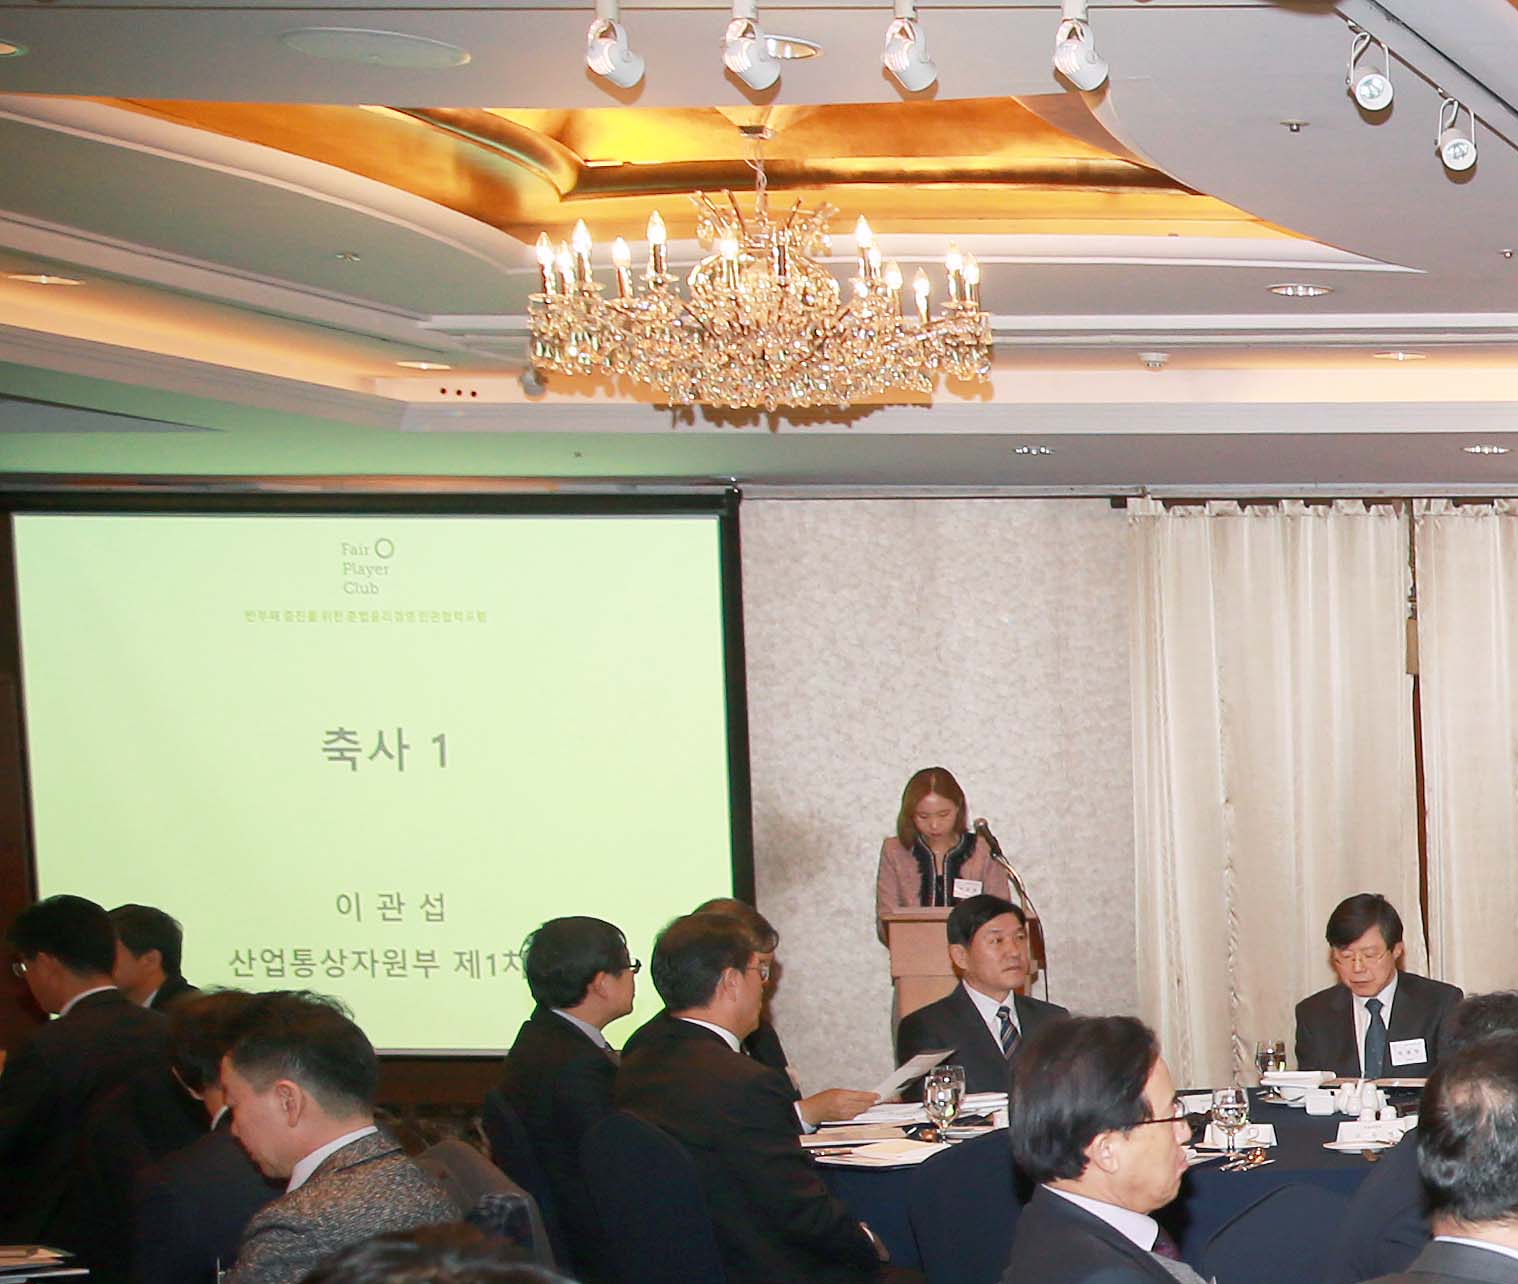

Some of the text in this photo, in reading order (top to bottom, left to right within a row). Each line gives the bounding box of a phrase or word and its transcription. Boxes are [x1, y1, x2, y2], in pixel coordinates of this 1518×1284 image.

[320, 726, 447, 773] 축사 1
[228, 948, 524, 980] 산업통상자원부 제1차
